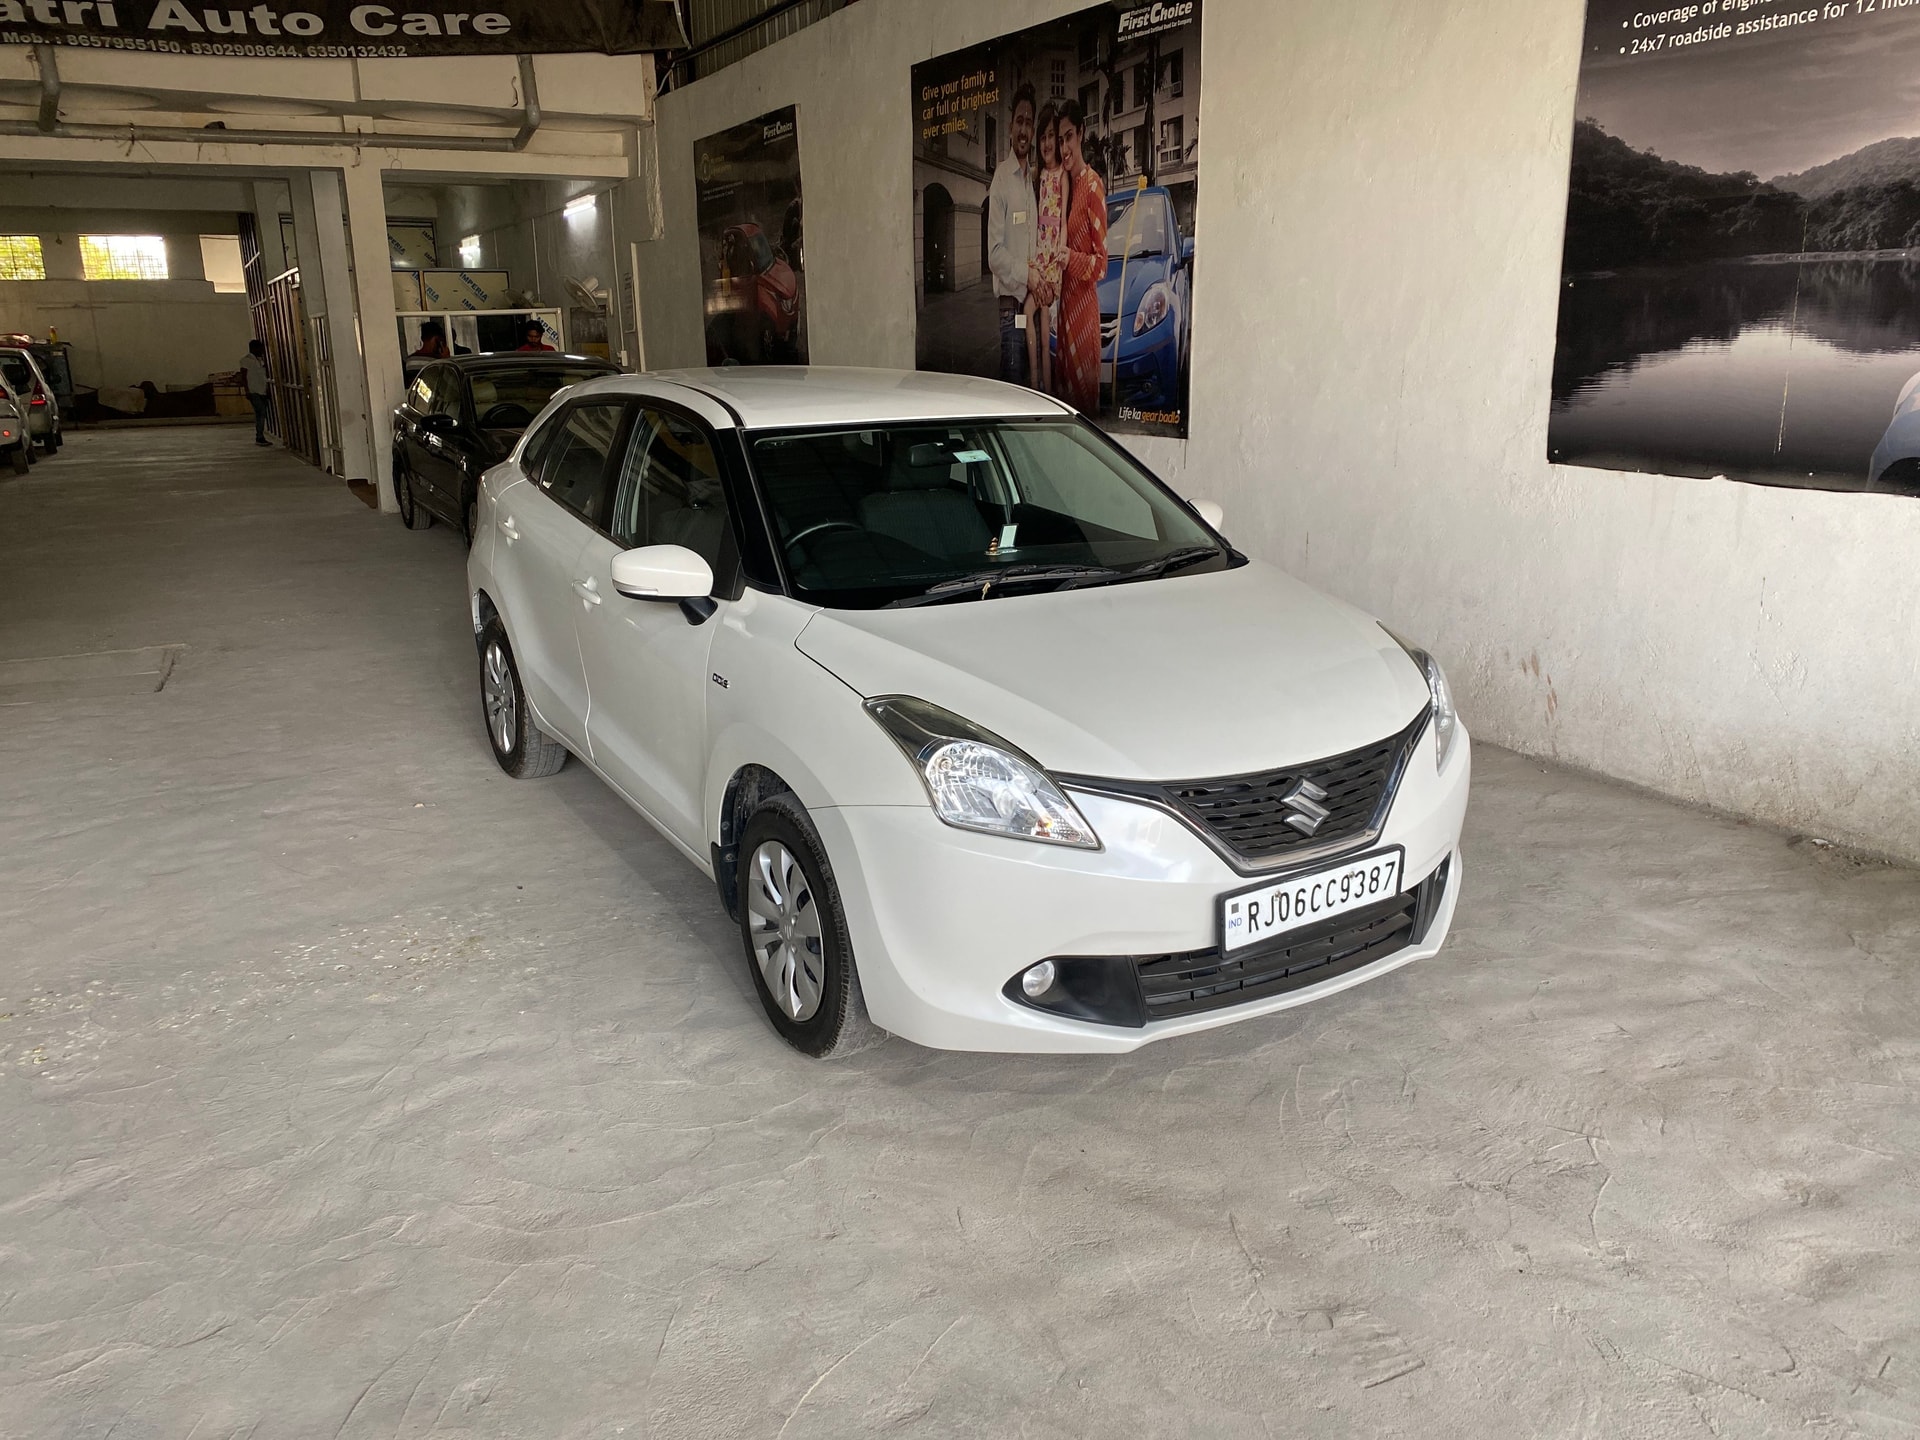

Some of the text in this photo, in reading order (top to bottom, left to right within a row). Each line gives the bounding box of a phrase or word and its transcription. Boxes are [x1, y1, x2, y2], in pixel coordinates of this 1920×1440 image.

[148, 0, 324, 36] Auto
[350, 4, 511, 36] Care
[1630, 33, 1666, 55] 24x7
[1668, 21, 1732, 48] roadside
[1735, 8, 1818, 36] assistance
[1823, 3, 1850, 20] for
[1856, 0, 1876, 14] 12
[1633, 9, 1698, 29] Coverage
[1702, 0, 1718, 14] of
[307, 45, 408, 58] 6350132432
[922, 70, 995, 101] Give your family a
[922, 87, 1000, 120] car full of brightest
[922, 117, 969, 139] ever smiles.
[459, 271, 488, 301] IMPERIA
[1118, 406, 1132, 422] Life
[1132, 407, 1141, 420] ka
[1141, 411, 1158, 423] gear
[1248, 861, 1396, 934] RJ06CC9387
[1228, 917, 1242, 929] IND
